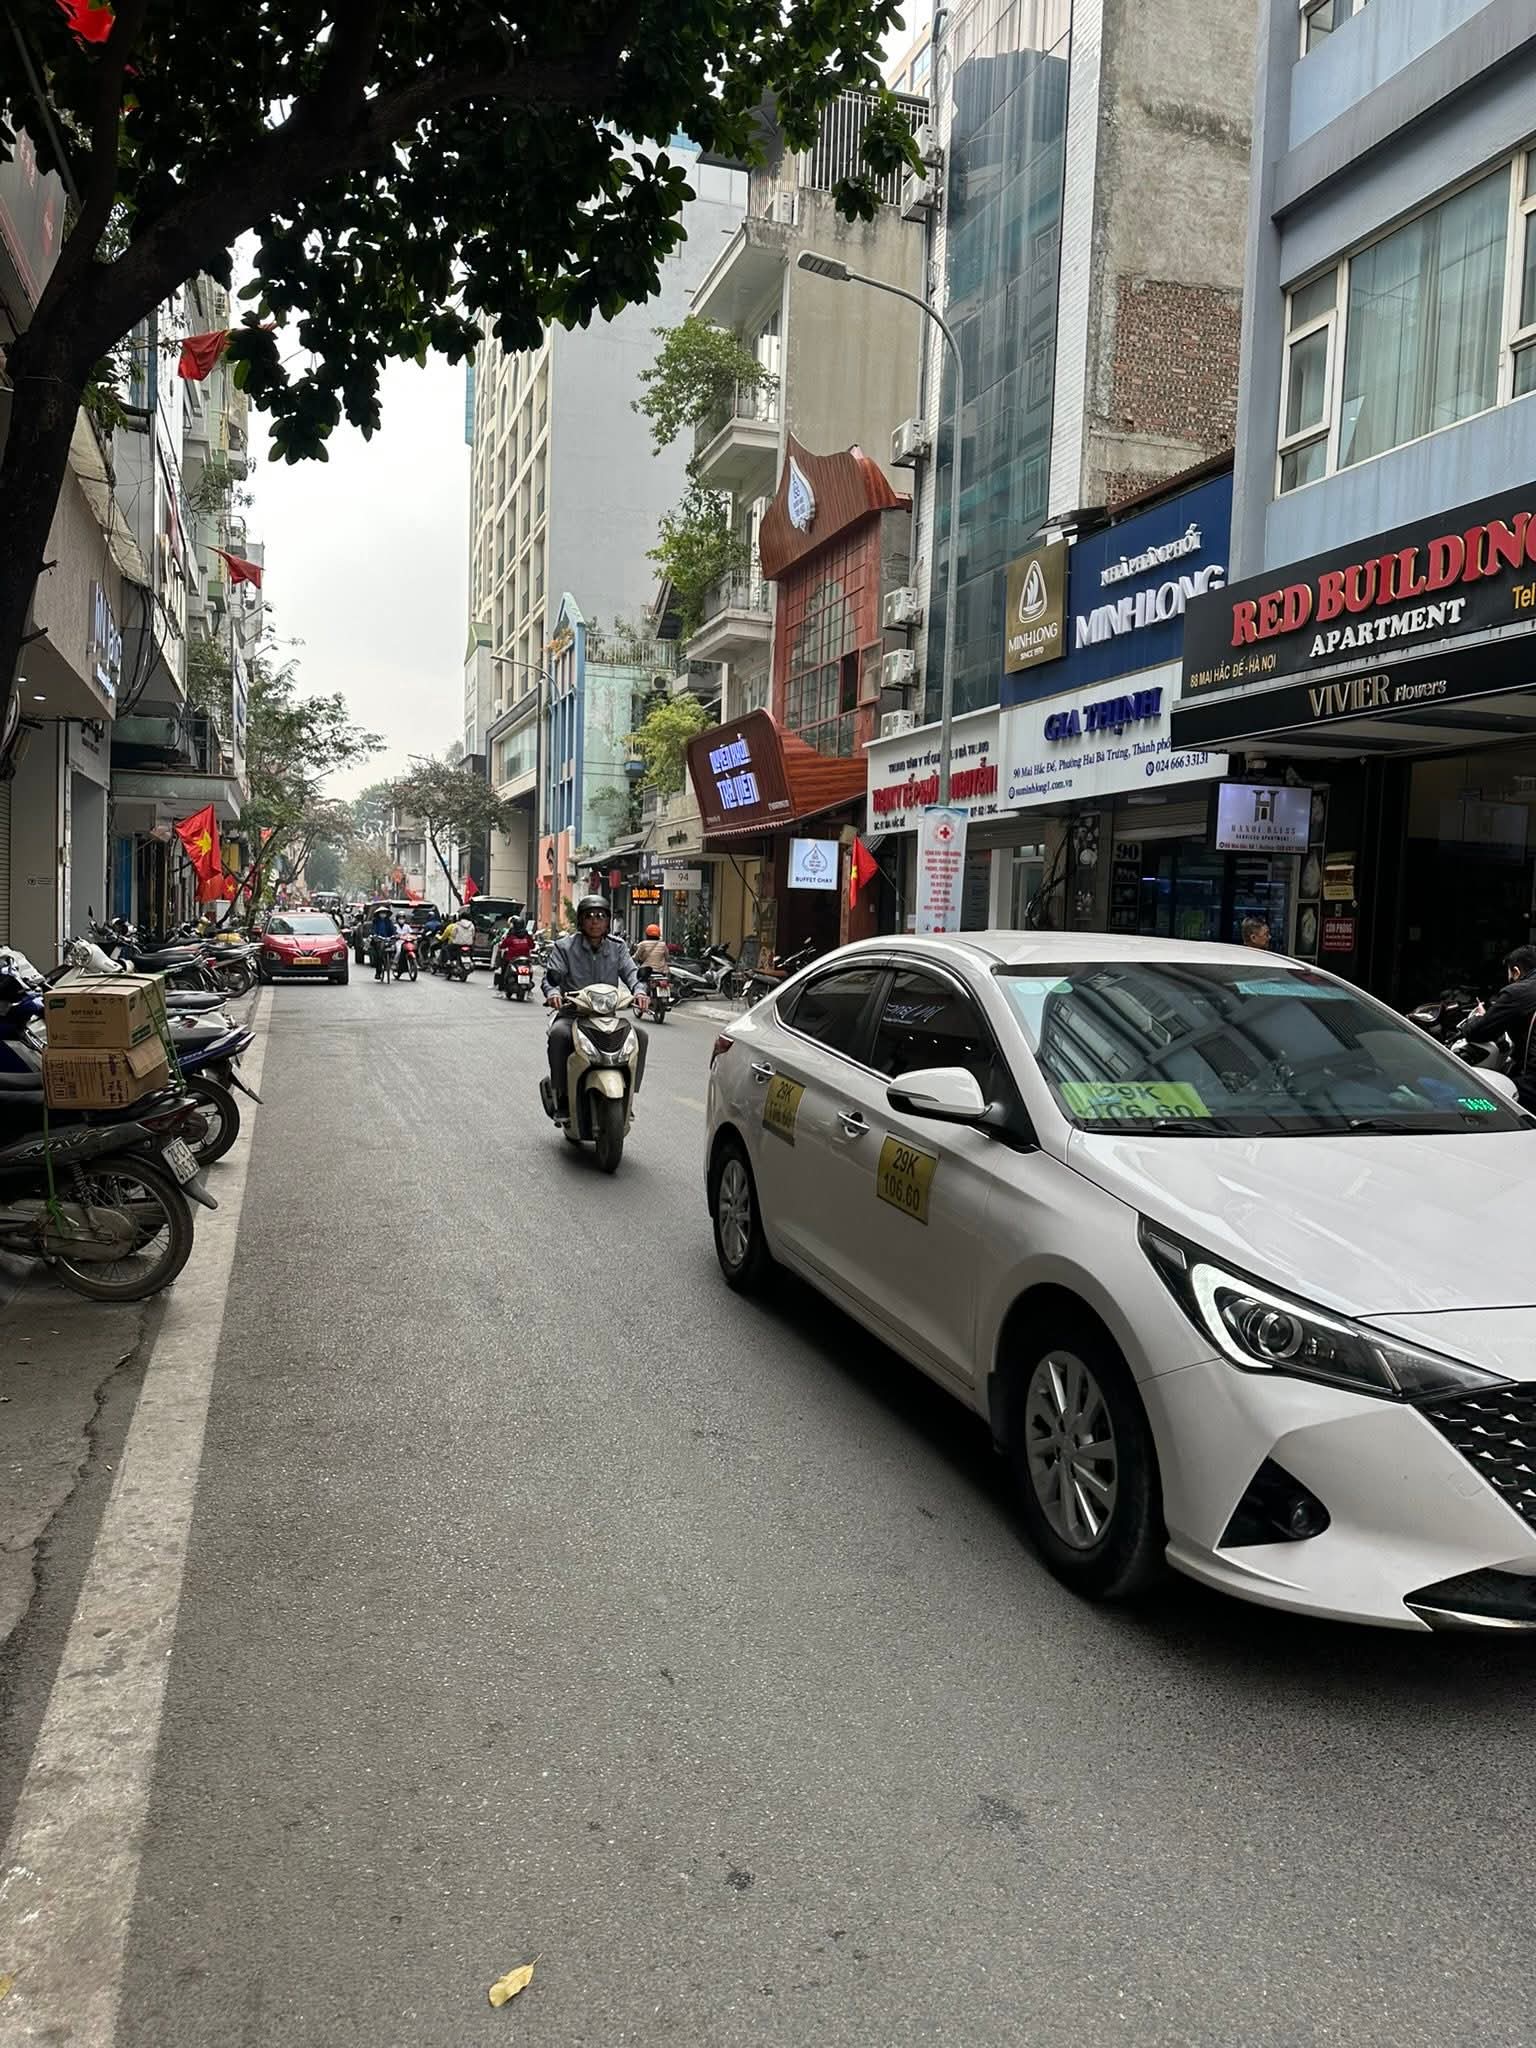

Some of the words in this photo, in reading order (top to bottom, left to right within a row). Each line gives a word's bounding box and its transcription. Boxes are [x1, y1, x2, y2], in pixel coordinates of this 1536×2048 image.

[1100, 556, 1130, 586] NHÀ
[1130, 546, 1166, 576] PHÂN
[1231, 583, 1312, 647] RED
[1308, 598, 1466, 658] APARTMENT
[1199, 670, 1213, 686] MAI
[1248, 654, 1260, 674] HÀ
[1044, 711, 1082, 742] GIA
[1083, 687, 1163, 736] THỊNH
[1308, 673, 1390, 717] VIVIER
[1394, 679, 1447, 703] Flowers
[1133, 740, 1155, 756] Thành
[678, 872, 689, 881] 94
[777, 1081, 795, 1101] 29K
[893, 1148, 919, 1179] 29K
[884, 1173, 920, 1212] 106.60
